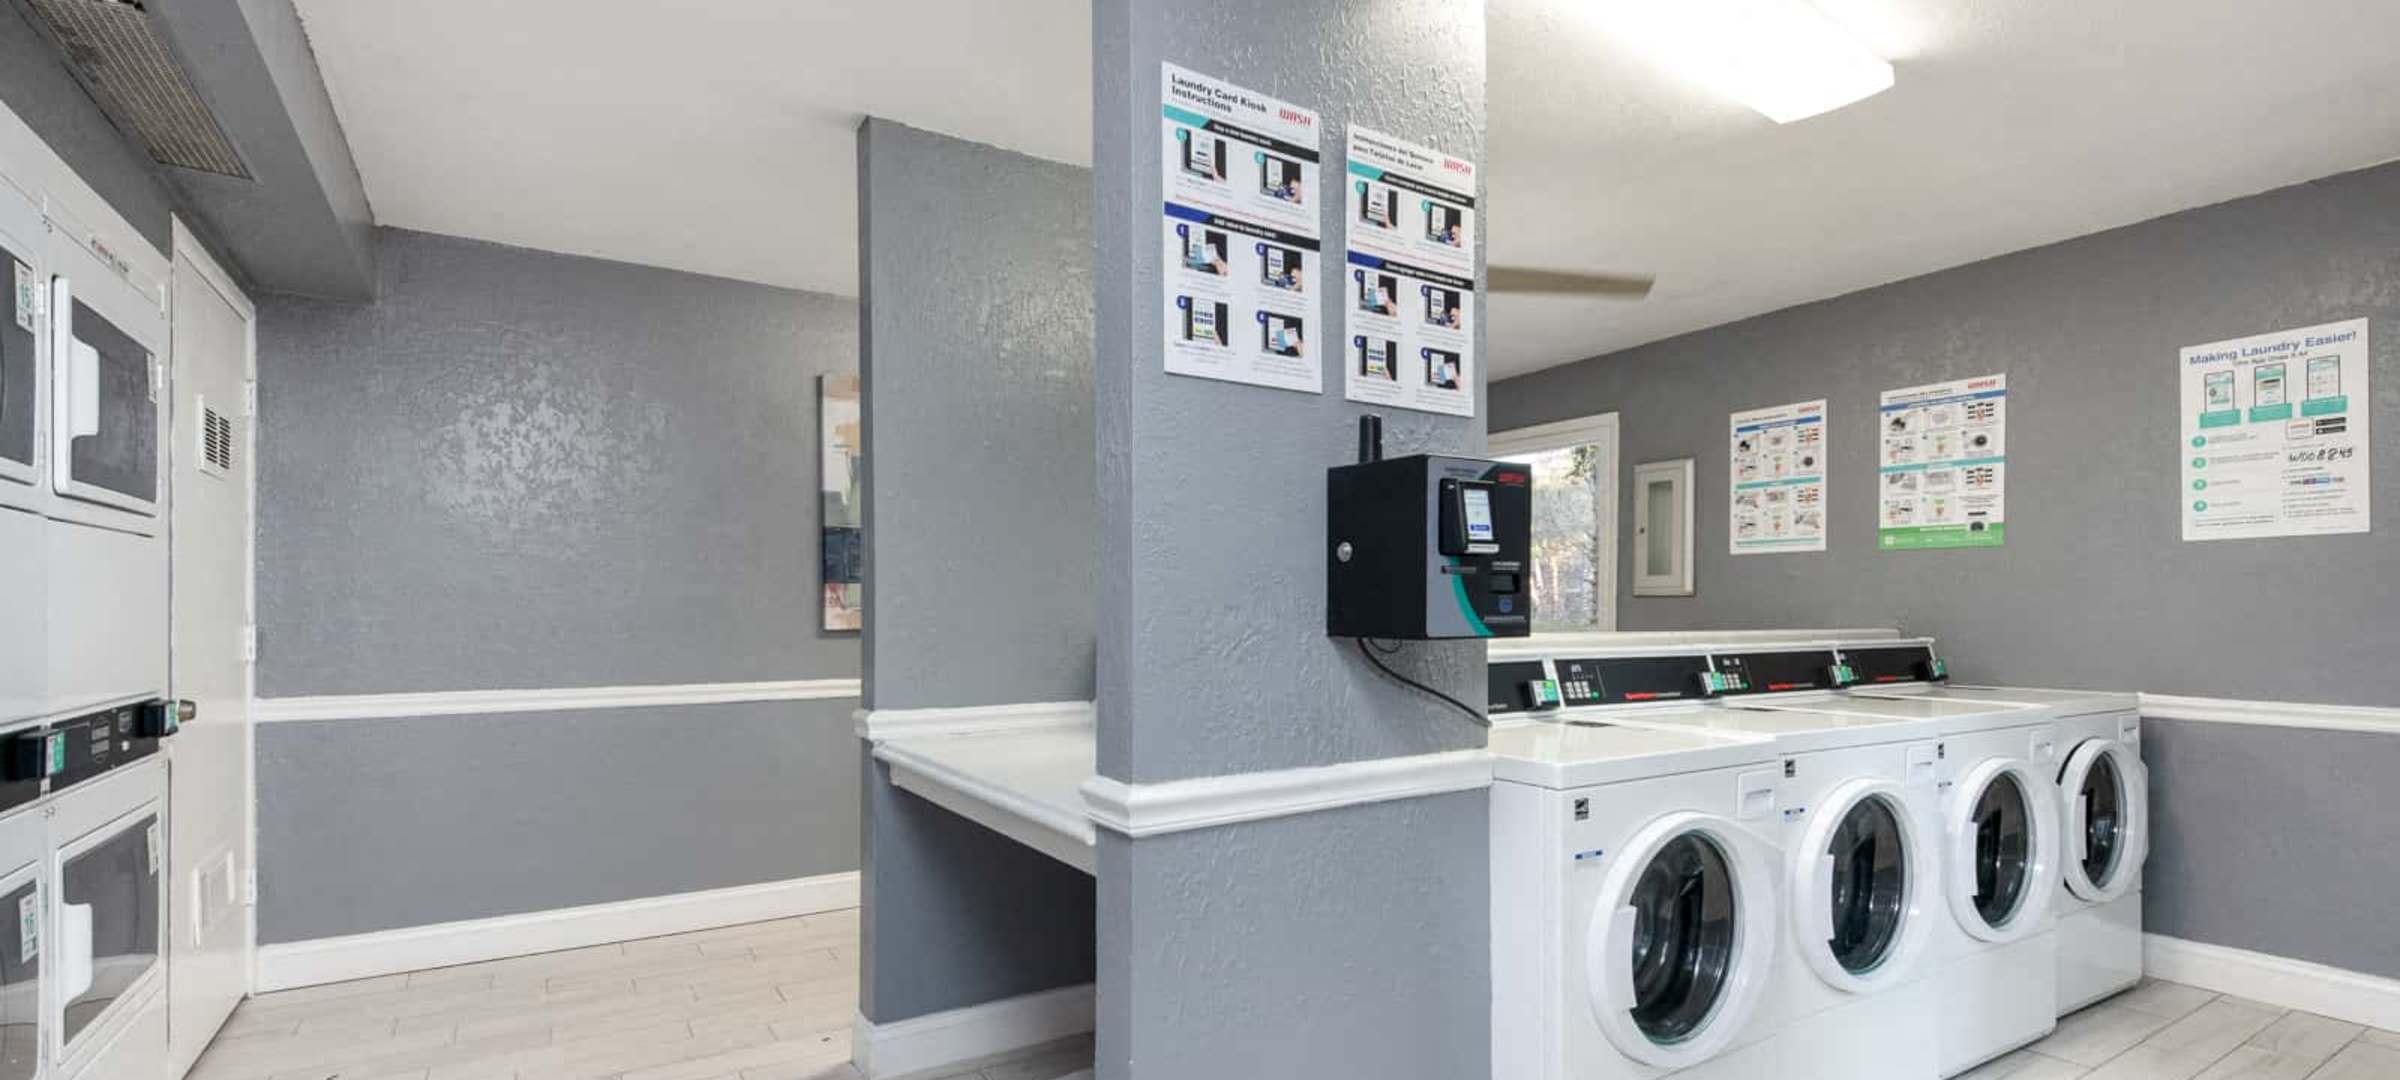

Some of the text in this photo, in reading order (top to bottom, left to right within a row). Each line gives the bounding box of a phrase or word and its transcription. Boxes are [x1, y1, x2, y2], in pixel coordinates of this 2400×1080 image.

[1172, 73, 1267, 112] Laundry Card Kiosk
[1172, 85, 1232, 112] Instructions
[2189, 331, 2358, 365] Making Laundry Easier!
